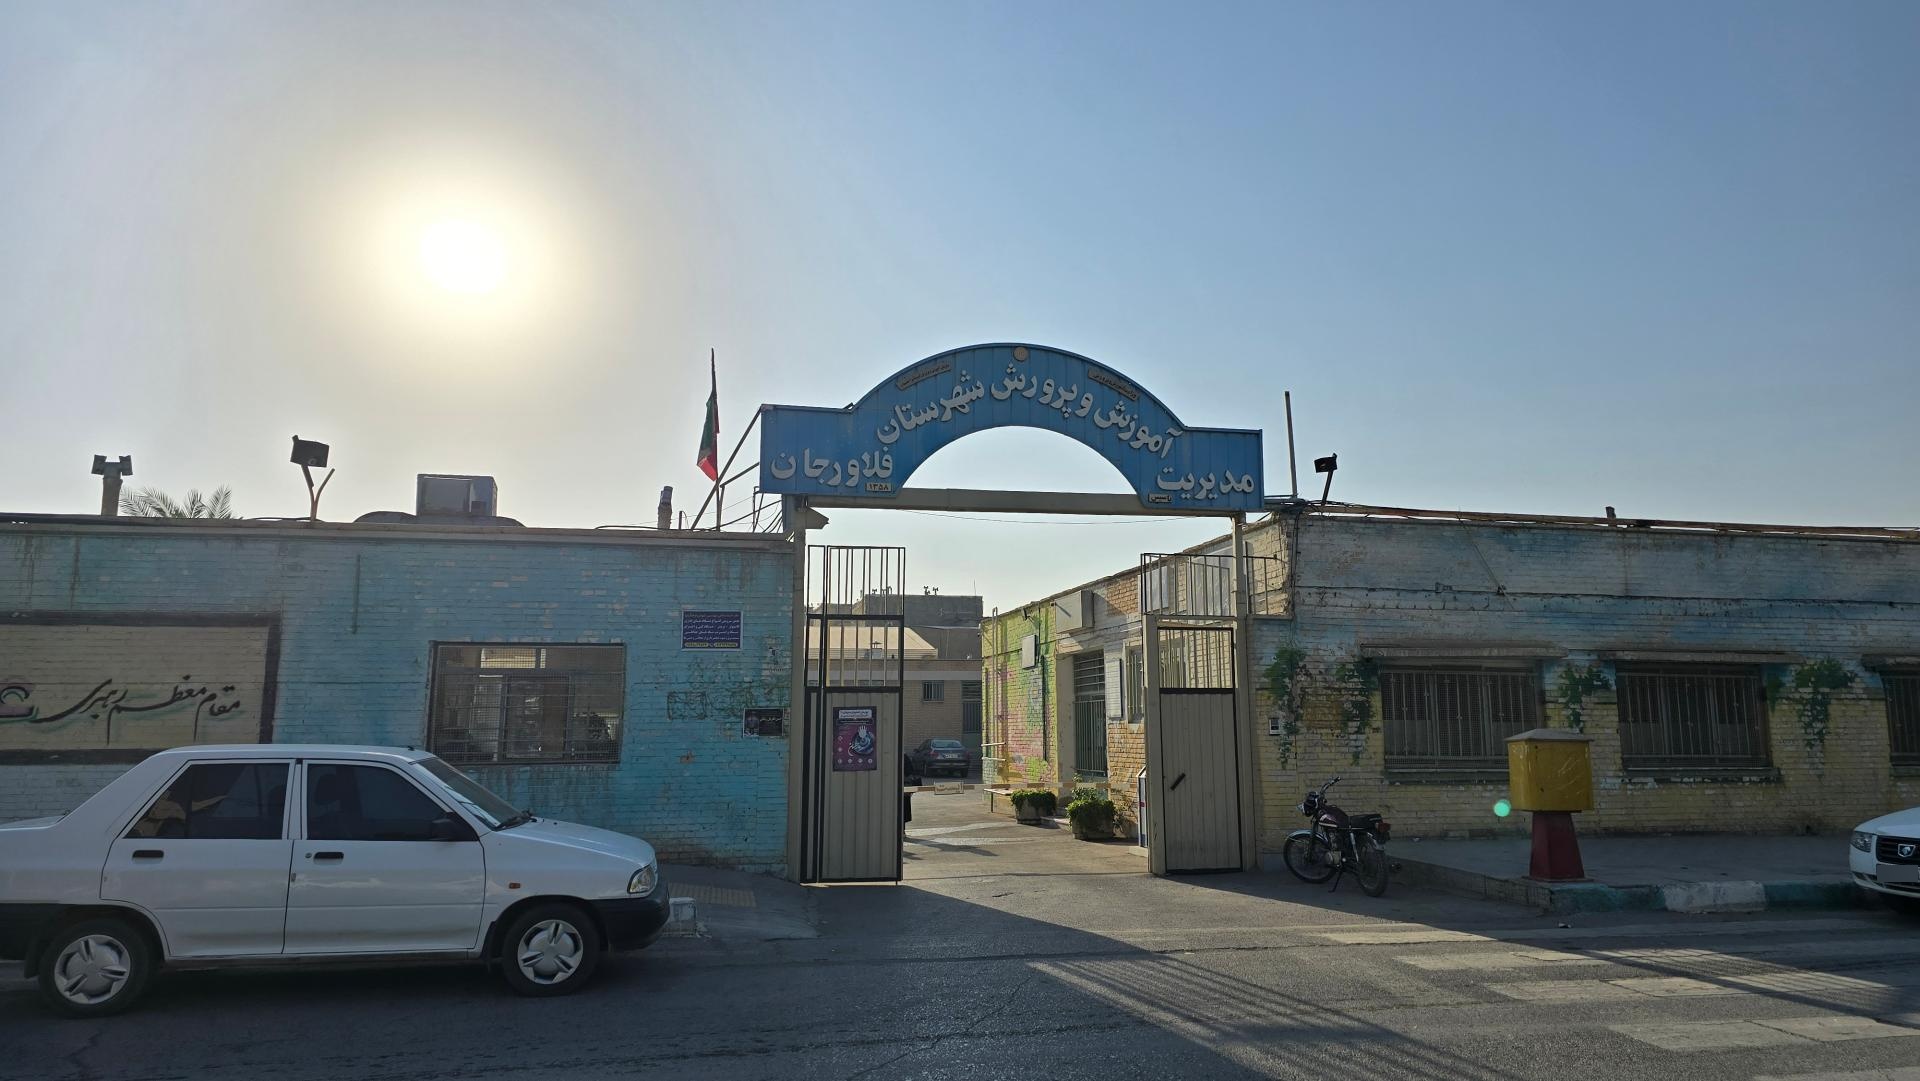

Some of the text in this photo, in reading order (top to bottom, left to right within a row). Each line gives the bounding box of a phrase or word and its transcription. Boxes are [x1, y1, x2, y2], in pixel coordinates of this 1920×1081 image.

[877, 369, 985, 444] شهرستان
[990, 362, 1078, 418] پرورش
[1074, 392, 1094, 417] و
[1093, 400, 1183, 459] آموزش
[771, 446, 893, 488] فلاورجان
[1156, 468, 1255, 500] مدیریت
[29, 678, 129, 724] رهبری
[106, 674, 208, 745] معظم
[193, 685, 241, 742] مقام
